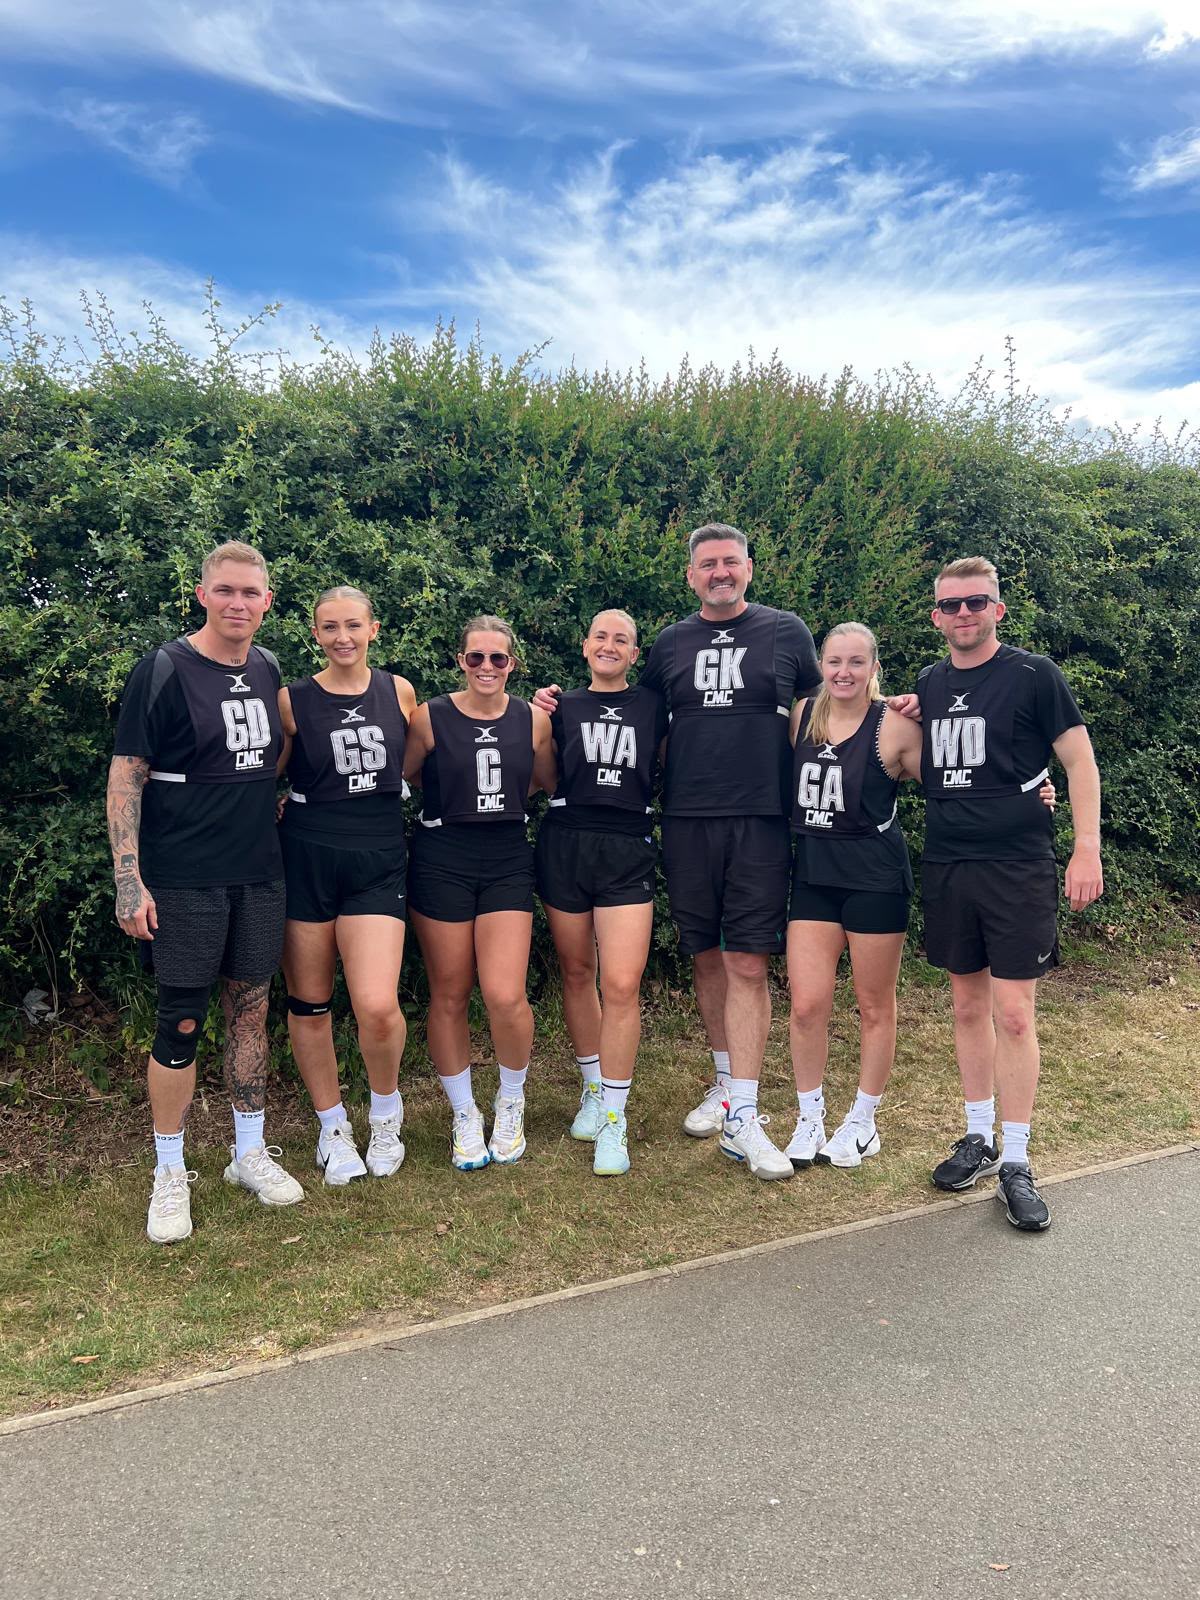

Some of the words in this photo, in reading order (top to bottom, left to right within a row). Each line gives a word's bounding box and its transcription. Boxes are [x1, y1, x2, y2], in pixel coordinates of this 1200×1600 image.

[693, 647, 748, 691] GK
[703, 690, 734, 704] CMC
[221, 698, 272, 752] GD
[329, 725, 387, 775] GS
[580, 722, 637, 769] WA
[930, 716, 986, 768] WD
[235, 749, 264, 767] CMC
[476, 748, 502, 794] C
[348, 772, 377, 790] CMC
[597, 768, 622, 784] CMC
[797, 762, 846, 812] GA
[943, 769, 972, 785] CMC
[477, 794, 505, 810] CMC
[805, 809, 834, 826] CMC
